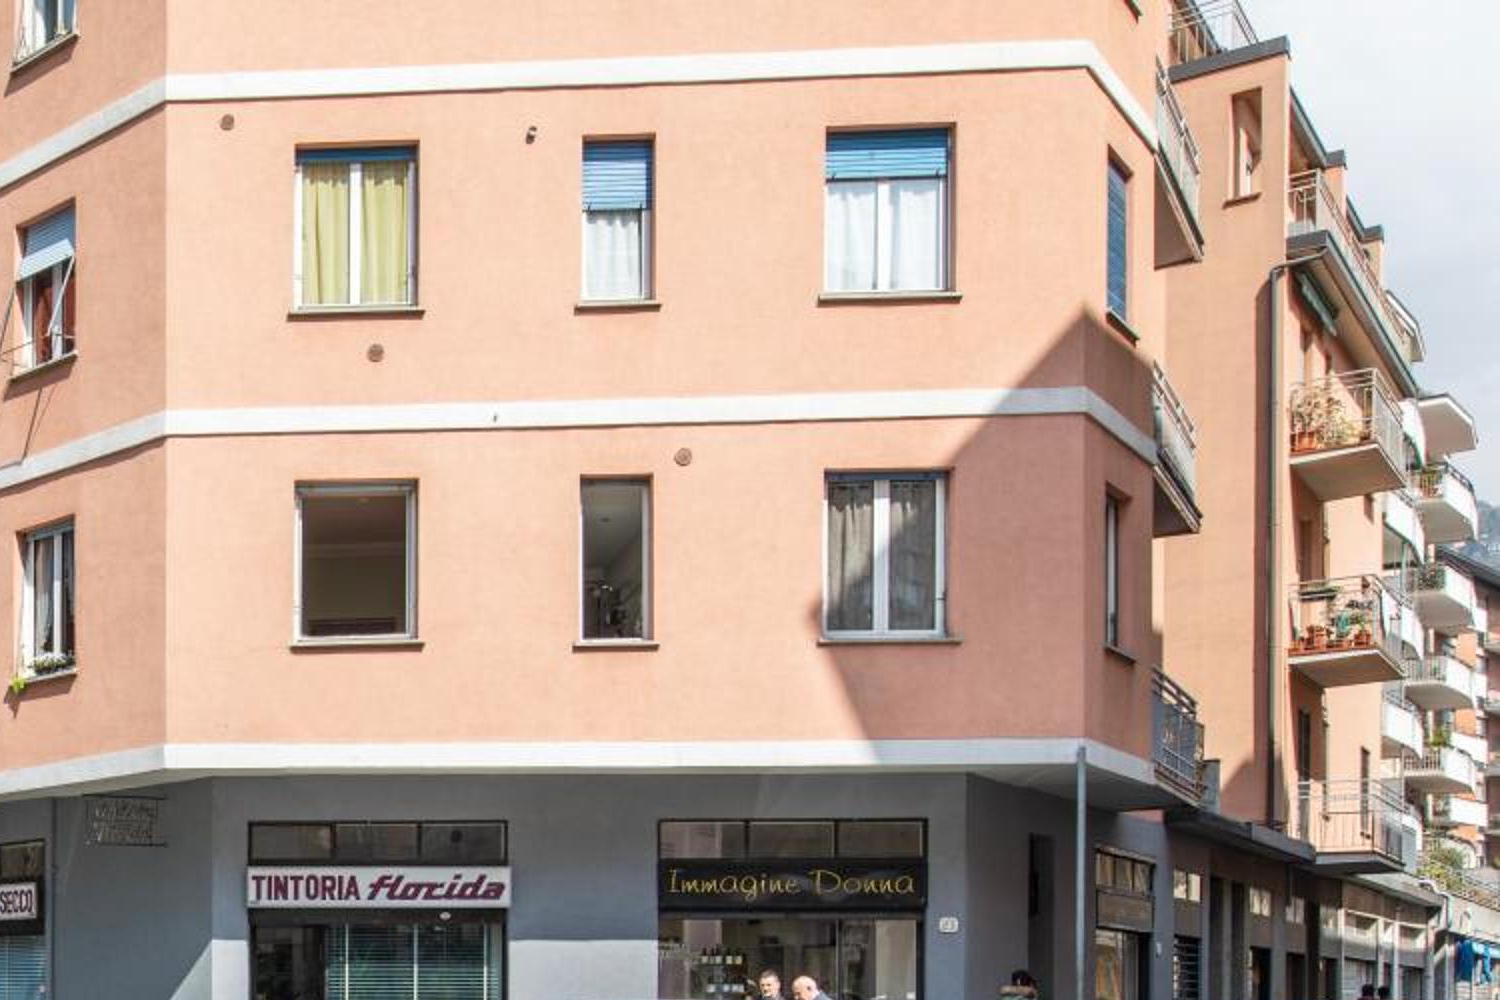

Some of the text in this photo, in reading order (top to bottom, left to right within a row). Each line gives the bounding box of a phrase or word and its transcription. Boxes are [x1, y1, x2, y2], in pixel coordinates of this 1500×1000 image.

[251, 874, 361, 900] TINTORIA
[667, 868, 915, 903] Immagine Donna
[0, 888, 33, 914] SECCO
